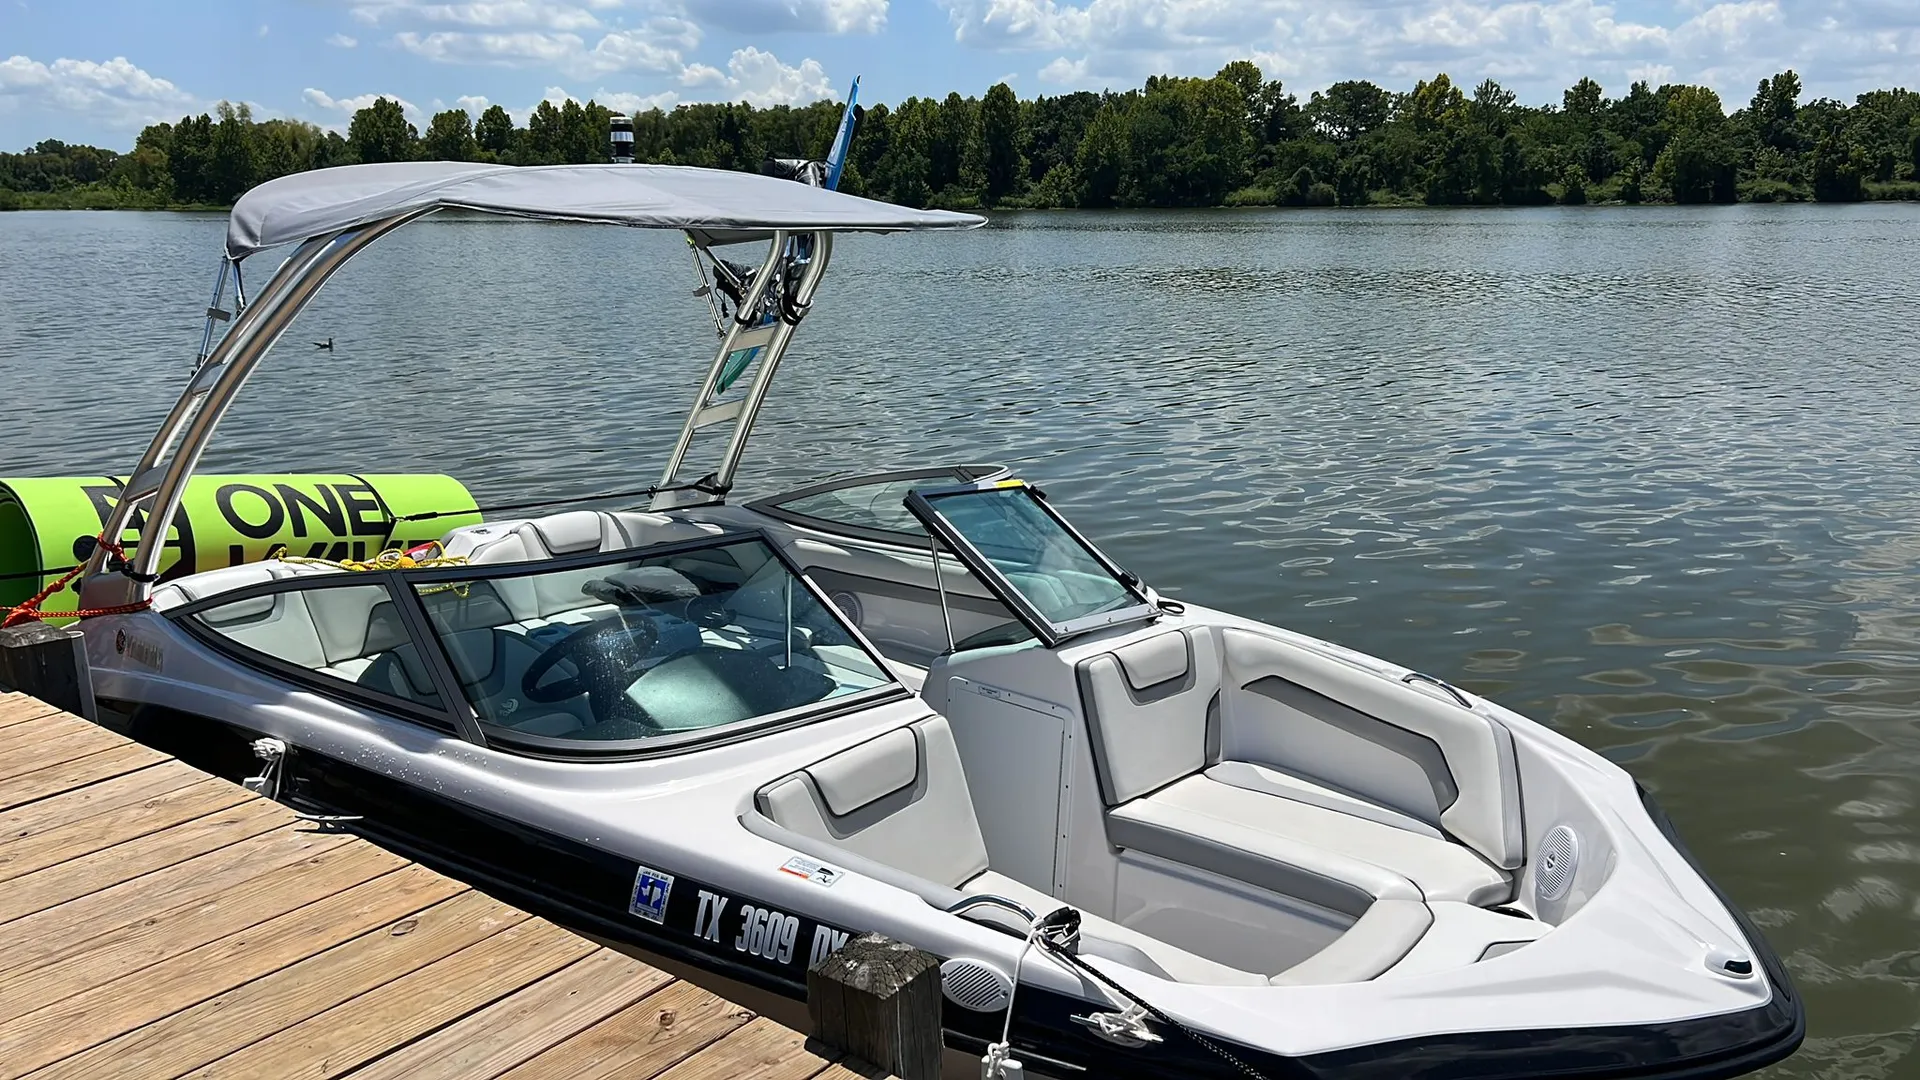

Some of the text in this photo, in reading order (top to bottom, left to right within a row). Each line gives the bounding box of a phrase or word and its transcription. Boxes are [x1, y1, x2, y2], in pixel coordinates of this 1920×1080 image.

[215, 484, 387, 540] ONE
[694, 889, 729, 943] TX
[735, 904, 800, 965] 3609
